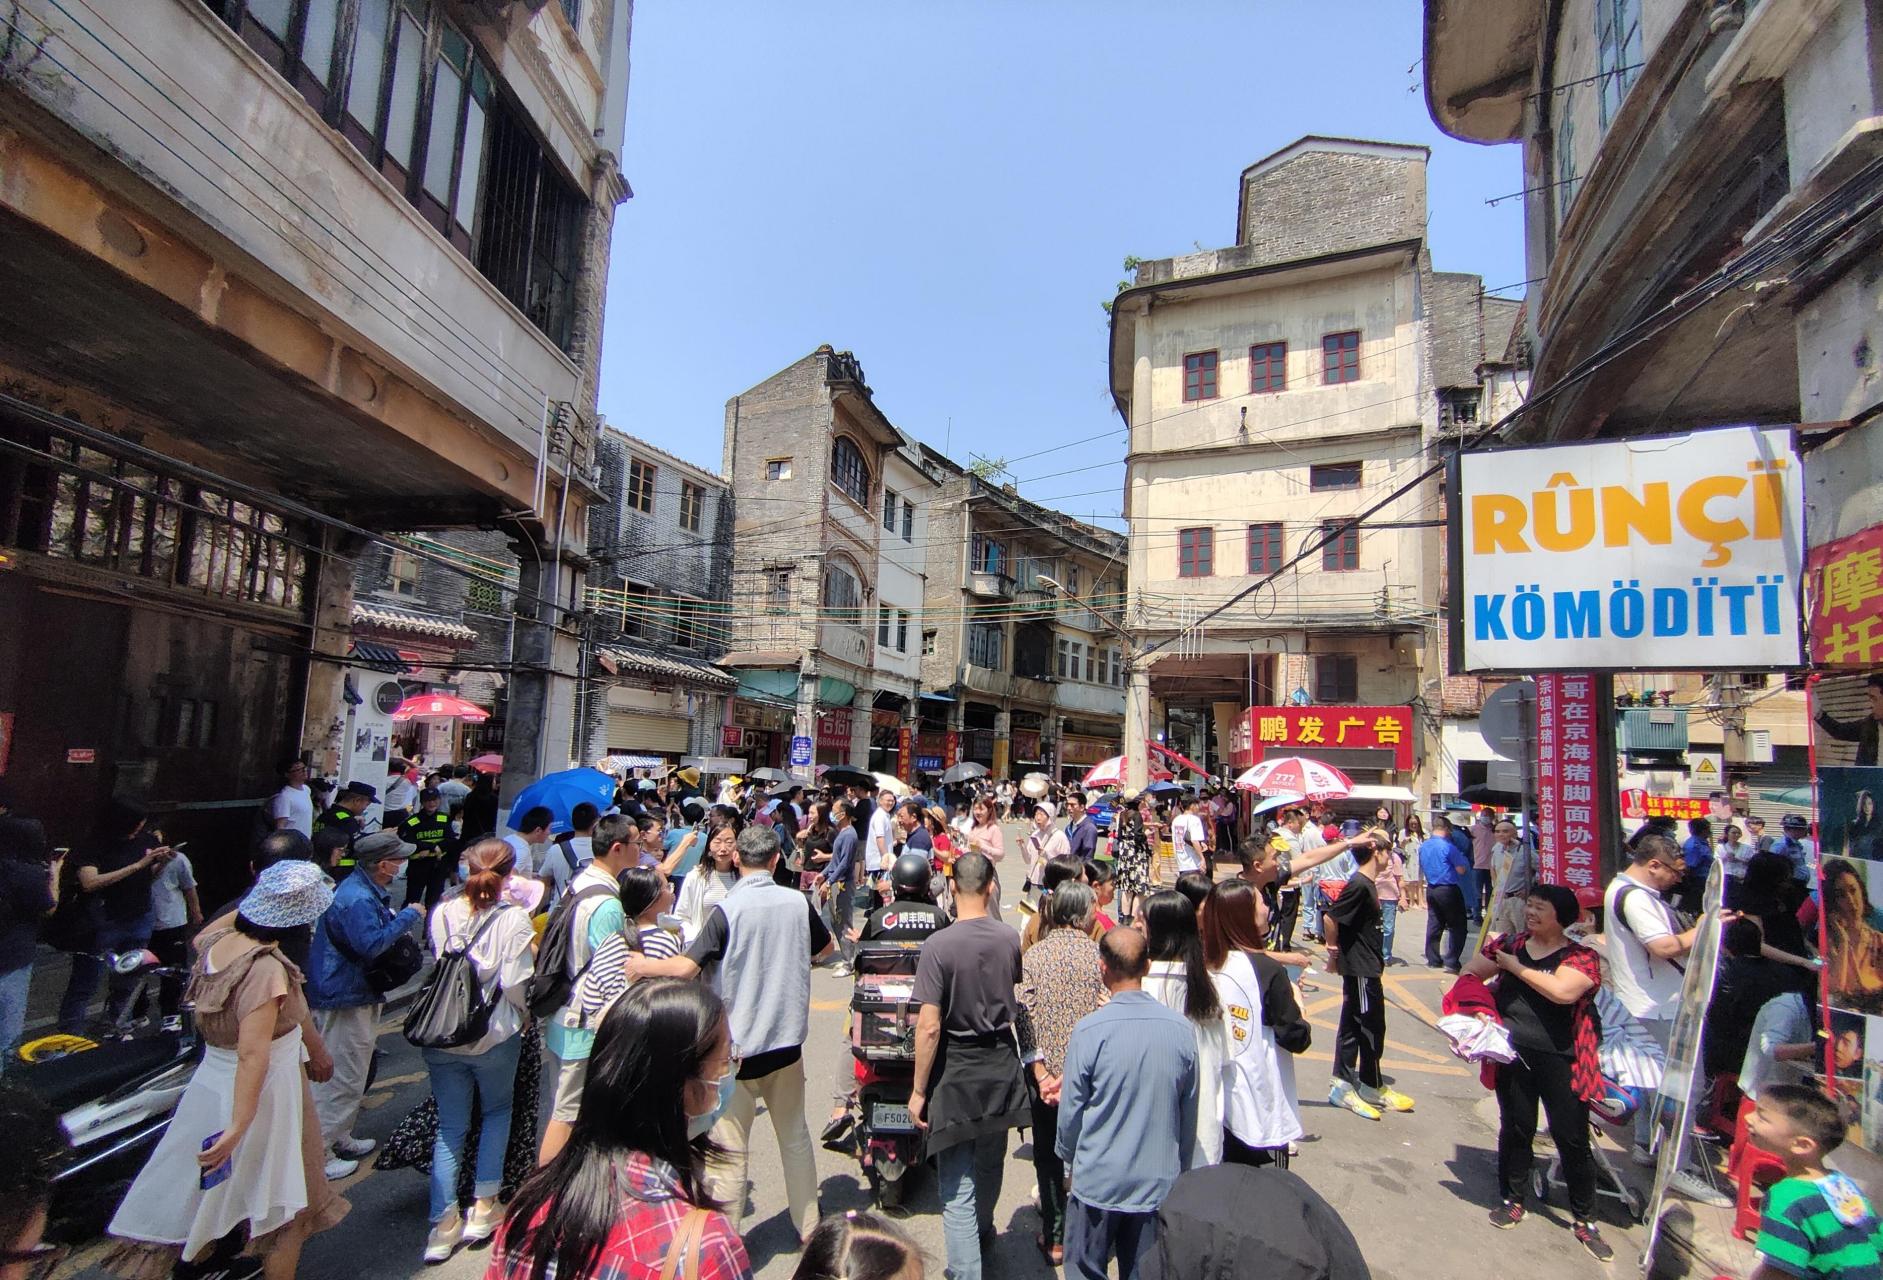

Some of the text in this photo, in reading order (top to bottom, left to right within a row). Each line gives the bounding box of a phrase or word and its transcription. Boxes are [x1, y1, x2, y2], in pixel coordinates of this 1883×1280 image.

[1259, 716, 1403, 744] 鹏发广告
[1539, 674, 1553, 777] 宗强盛猪脚面
[1275, 773, 1296, 782] 777
[1560, 674, 1593, 887] 哥在京海猪脚面协会等
[899, 911, 935, 924] 顺丰同城
